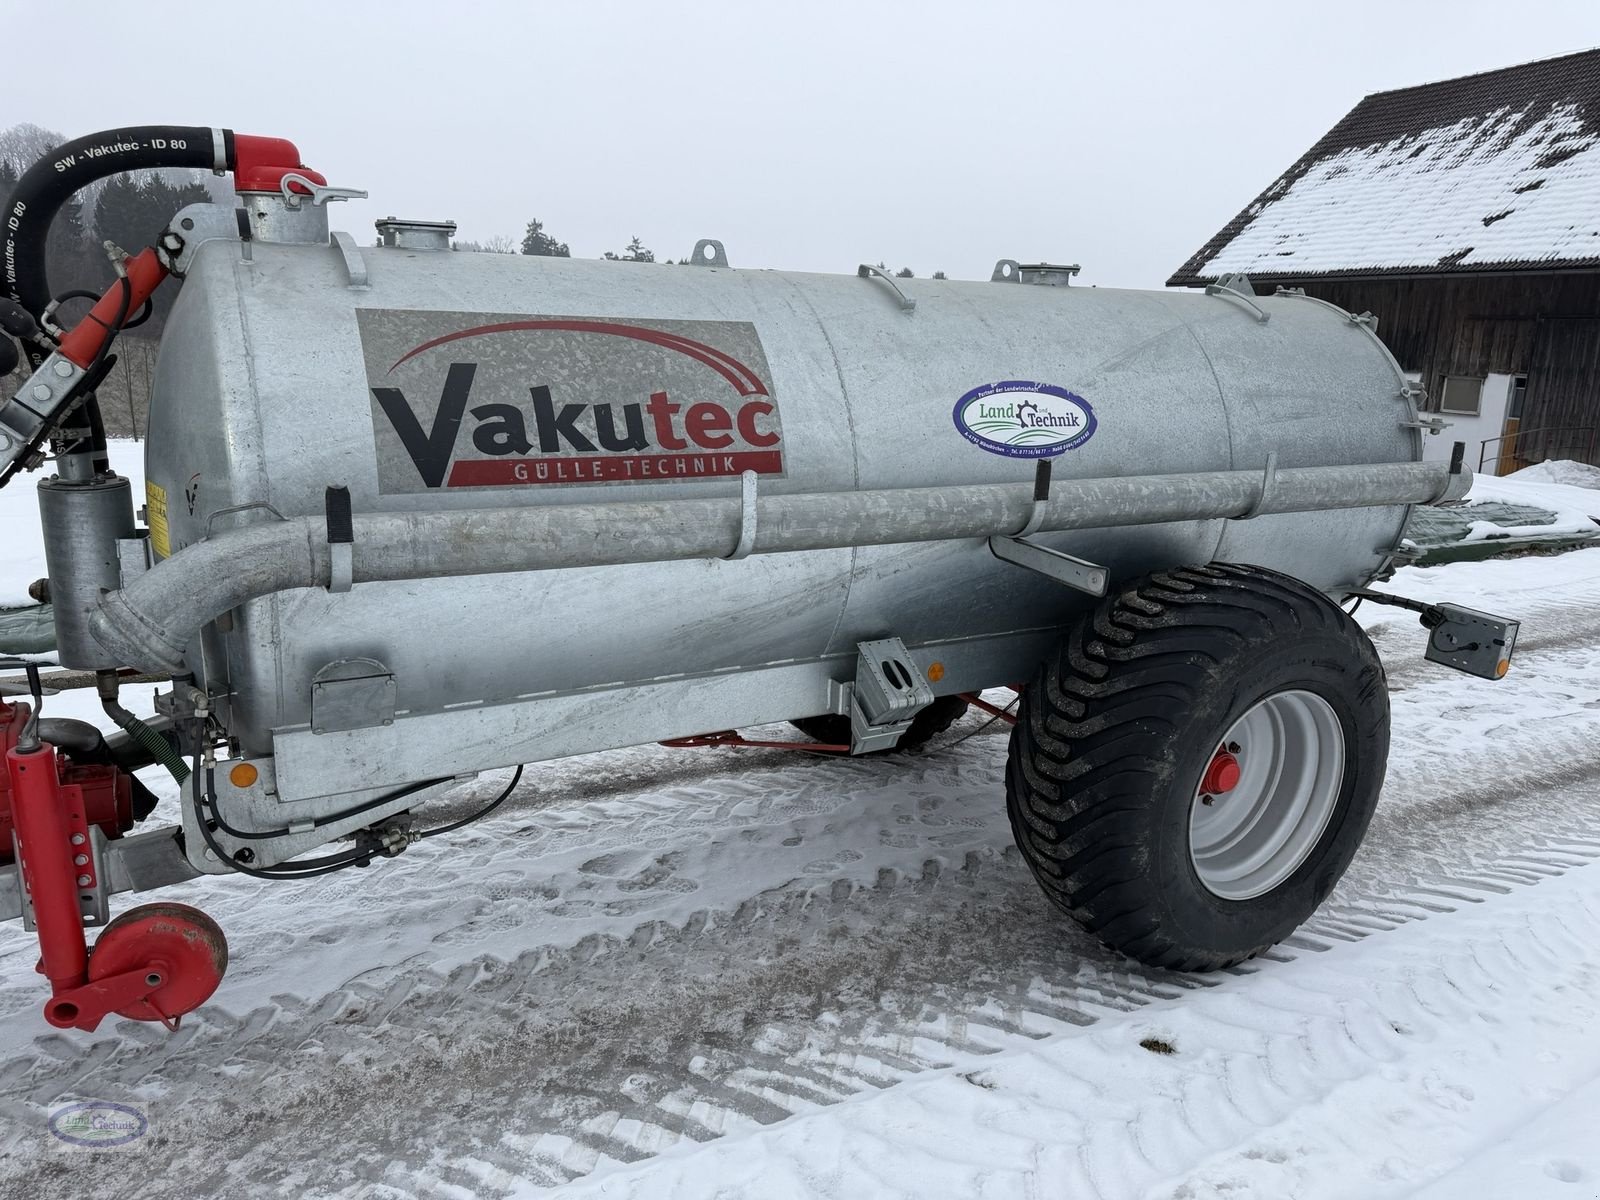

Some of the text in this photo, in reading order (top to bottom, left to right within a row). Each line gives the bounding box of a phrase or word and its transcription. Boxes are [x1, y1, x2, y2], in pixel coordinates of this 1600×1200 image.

[54, 154, 76, 173] SW
[84, 140, 140, 159] Vakutec
[152, 138, 167, 149] ID
[170, 139, 187, 150] 80
[14, 201, 27, 217] 80
[8, 217, 21, 231] ID
[6, 239, 16, 284] Vakutec
[980, 403, 1015, 418] Land
[1028, 412, 1080, 428] Technik
[371, 363, 781, 488] Vakutec
[514, 455, 737, 481] GÜLLE-TECHNIK
